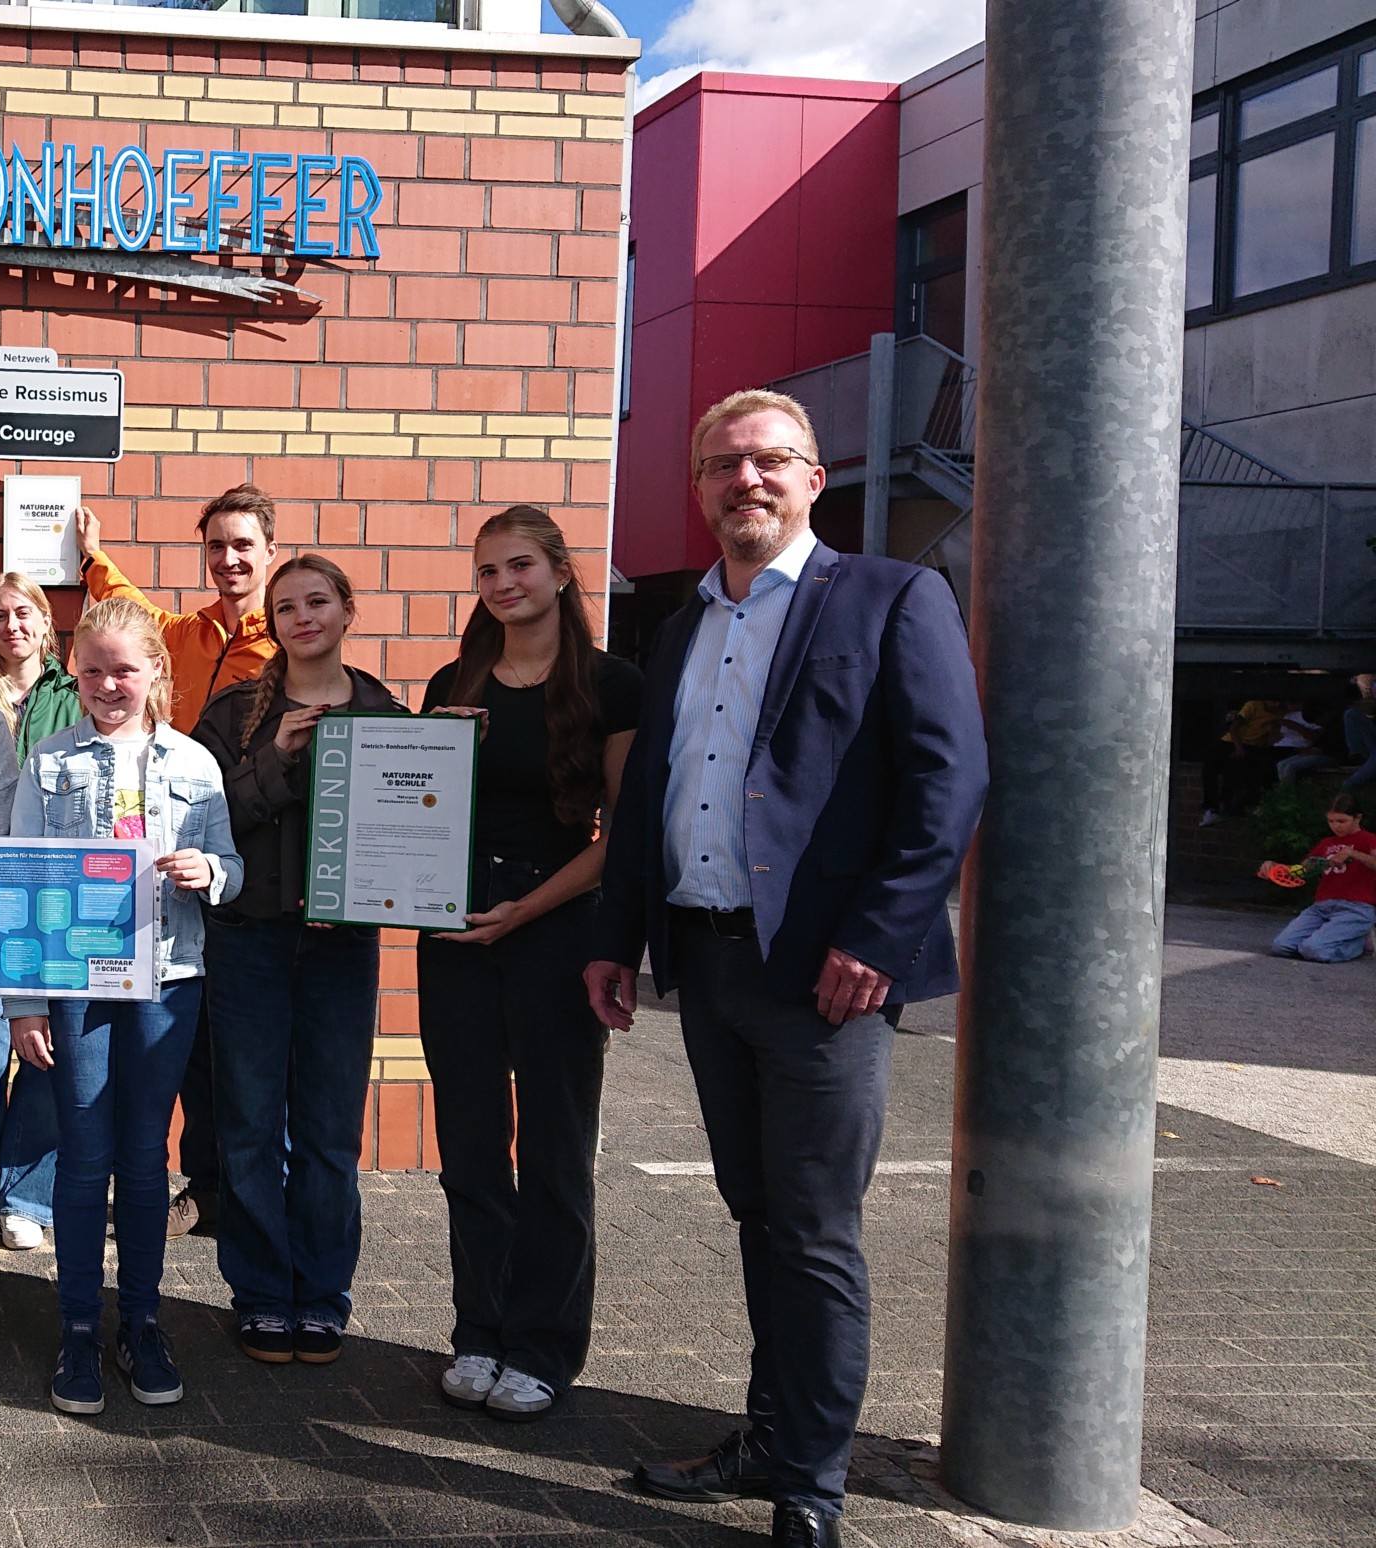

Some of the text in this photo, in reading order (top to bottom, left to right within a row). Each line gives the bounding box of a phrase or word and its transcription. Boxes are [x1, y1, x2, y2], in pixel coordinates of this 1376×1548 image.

[3, 353, 51, 364] Netzwerk
[15, 385, 108, 403] Rassismus
[0, 424, 76, 445] Courage
[19, 503, 65, 511] NATURPARK
[381, 771, 434, 780] NATURPARK
[394, 780, 427, 788] SCHULE
[315, 724, 348, 911] URKUNDE
